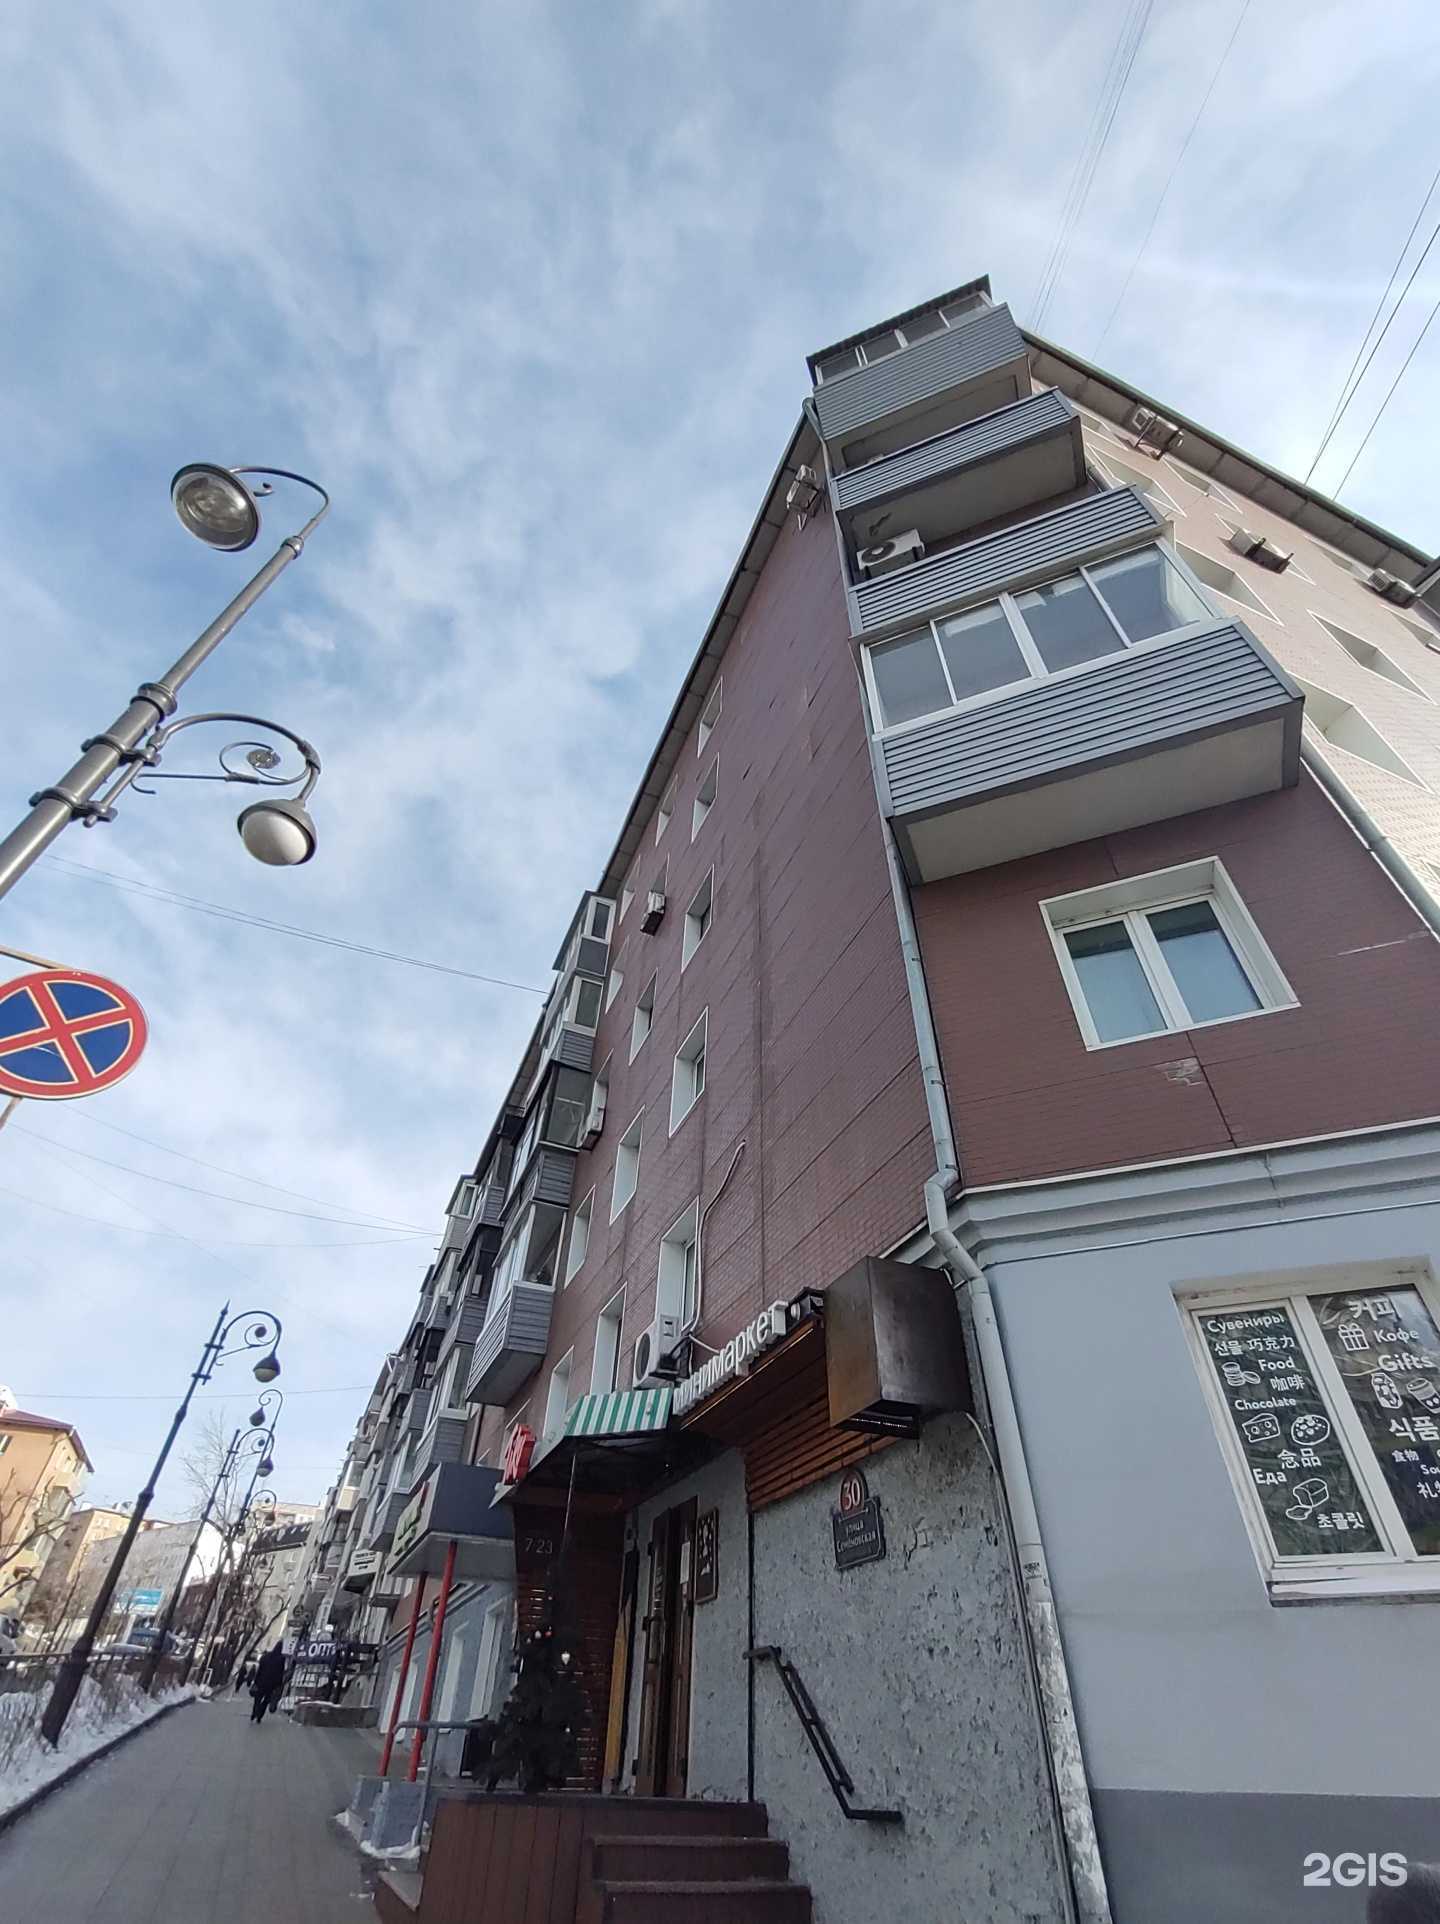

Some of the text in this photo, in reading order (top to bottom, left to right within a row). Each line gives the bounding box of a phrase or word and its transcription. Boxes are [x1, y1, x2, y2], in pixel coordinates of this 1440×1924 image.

[1207, 1314, 1285, 1334] Сувениры
[1247, 1335, 1295, 1351] 巧克力
[1373, 1328, 1420, 1344] Кофе
[1214, 1340, 1243, 1356] 선물
[672, 1300, 788, 1416] минимаркет
[1258, 1356, 1295, 1371] Food
[1378, 1352, 1436, 1372] Gifts
[1270, 1374, 1305, 1391] 咖啡
[1234, 1397, 1297, 1411] Chocolate
[1389, 1416, 1440, 1442] 식품
[1277, 1448, 1322, 1469] 念品
[1253, 1468, 1287, 1485] Еда
[841, 1478, 861, 1511] 30
[1317, 1511, 1365, 1530] 초콜릿
